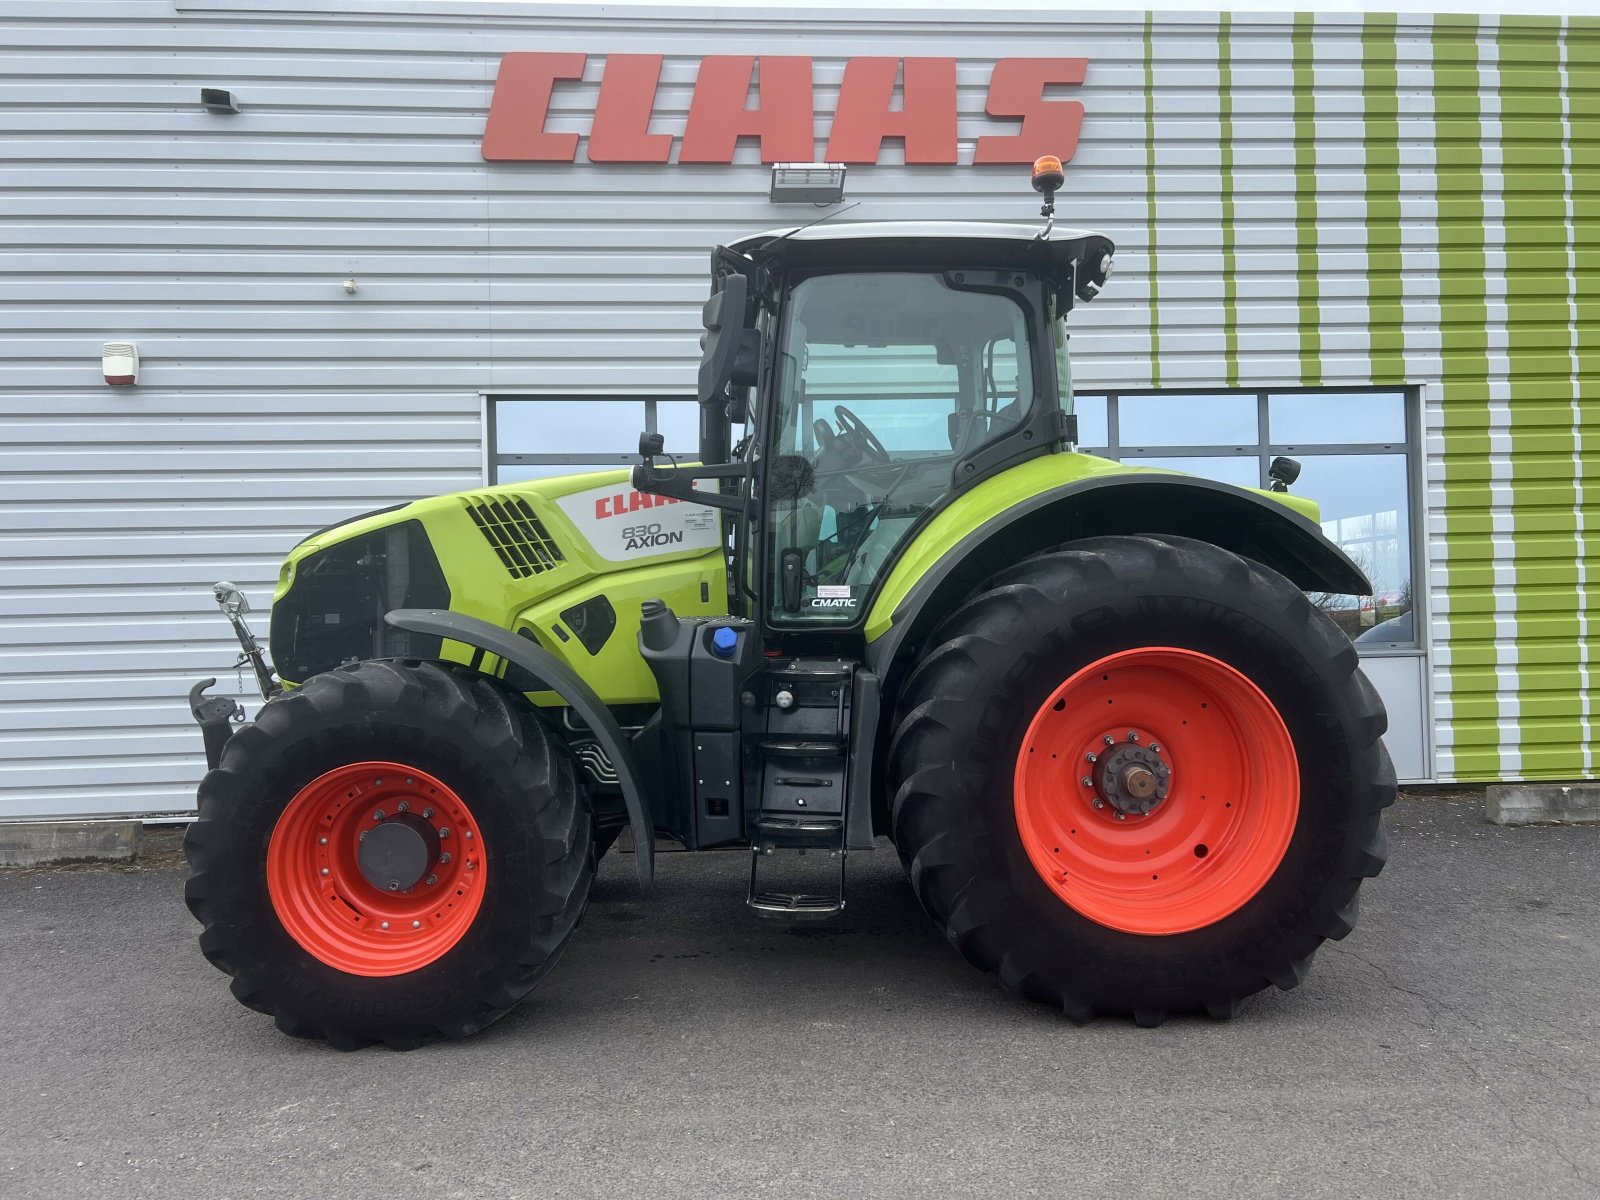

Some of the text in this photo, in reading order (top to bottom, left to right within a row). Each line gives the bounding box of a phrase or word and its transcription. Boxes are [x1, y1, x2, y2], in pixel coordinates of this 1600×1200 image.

[481, 51, 1089, 166] CLAAS
[595, 481, 698, 519] CLA
[622, 523, 661, 539] 830
[625, 530, 683, 551] AXION
[811, 598, 857, 607] CMATIC
